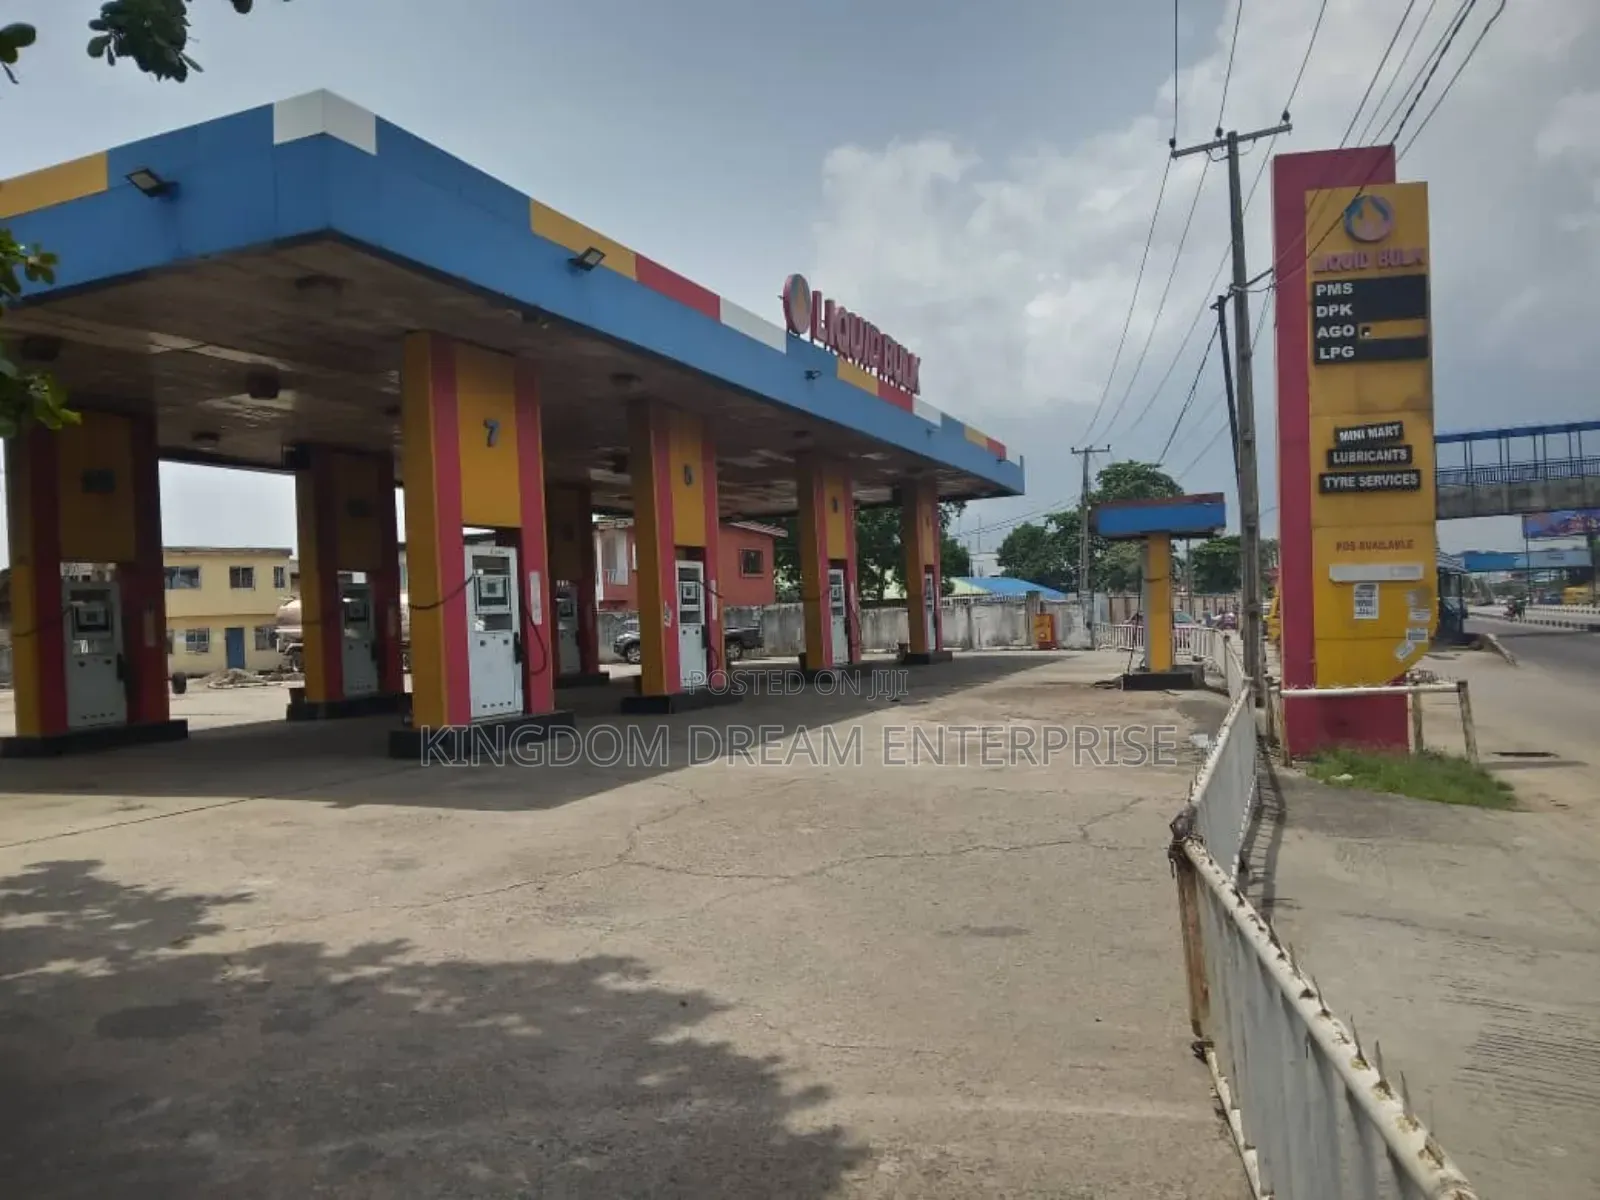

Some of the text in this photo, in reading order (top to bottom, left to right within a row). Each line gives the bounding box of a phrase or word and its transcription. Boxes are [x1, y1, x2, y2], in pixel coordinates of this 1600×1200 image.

[1316, 282, 1354, 297] PMS
[1316, 304, 1353, 318] DPK
[1316, 325, 1356, 339] AGO
[1319, 346, 1355, 360] LPG
[482, 418, 500, 448] 7
[1339, 424, 1401, 442] MINI MART
[1333, 448, 1407, 464] LUBRICANTS
[1323, 473, 1418, 489] TYRE SERVICES
